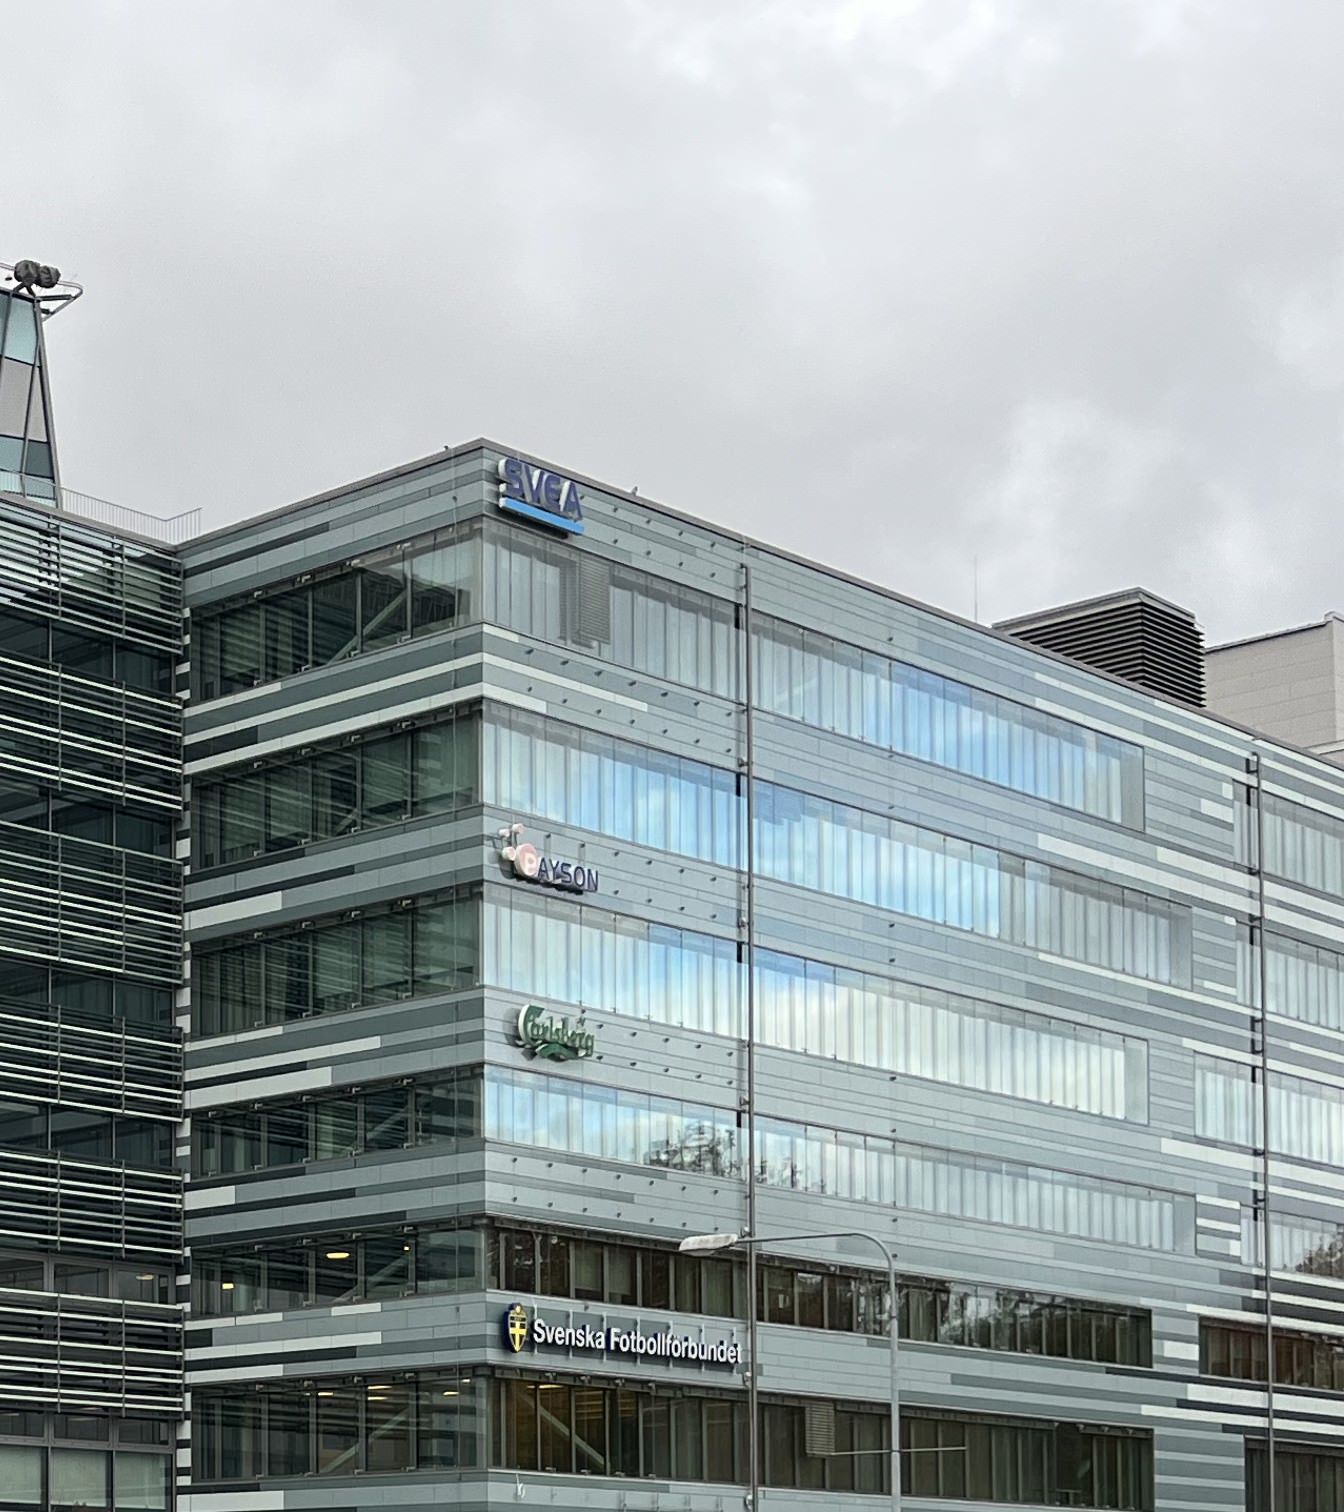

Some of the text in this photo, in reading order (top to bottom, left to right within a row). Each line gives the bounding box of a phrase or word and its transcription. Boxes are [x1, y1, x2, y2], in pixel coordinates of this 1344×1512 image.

[499, 458, 583, 521] SVEA
[524, 853, 599, 893] PAYSON
[518, 1004, 594, 1057] Carlsberg
[533, 1318, 742, 1364] Svenska Fotbollförbundet
